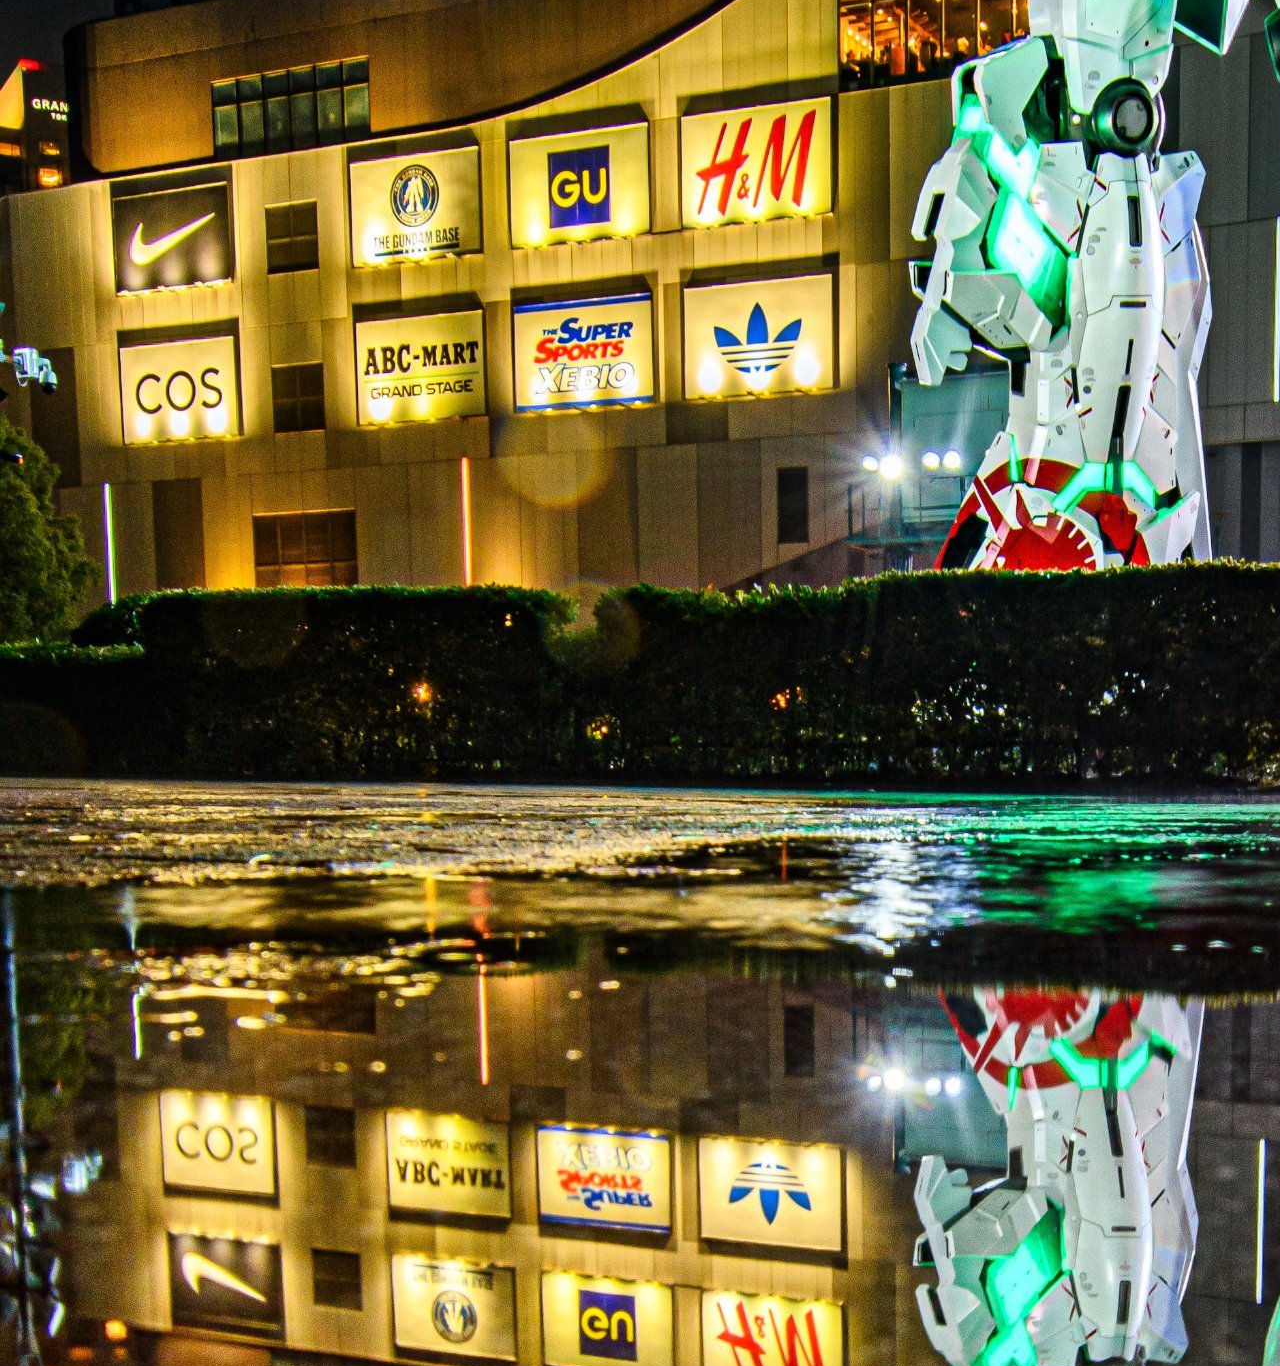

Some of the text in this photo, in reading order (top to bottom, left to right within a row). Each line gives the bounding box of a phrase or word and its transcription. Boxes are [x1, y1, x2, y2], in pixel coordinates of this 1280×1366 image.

[696, 109, 817, 215] H&M
[551, 166, 607, 208] GU
[374, 227, 460, 249] THE GUNDAM BASE
[557, 317, 634, 344] SUPER
[364, 341, 479, 376] ABC-MART
[534, 337, 624, 364] SPORTS
[136, 367, 223, 415] COS
[371, 379, 474, 400] GRAND STAGE
[535, 362, 635, 395] XEBIO
